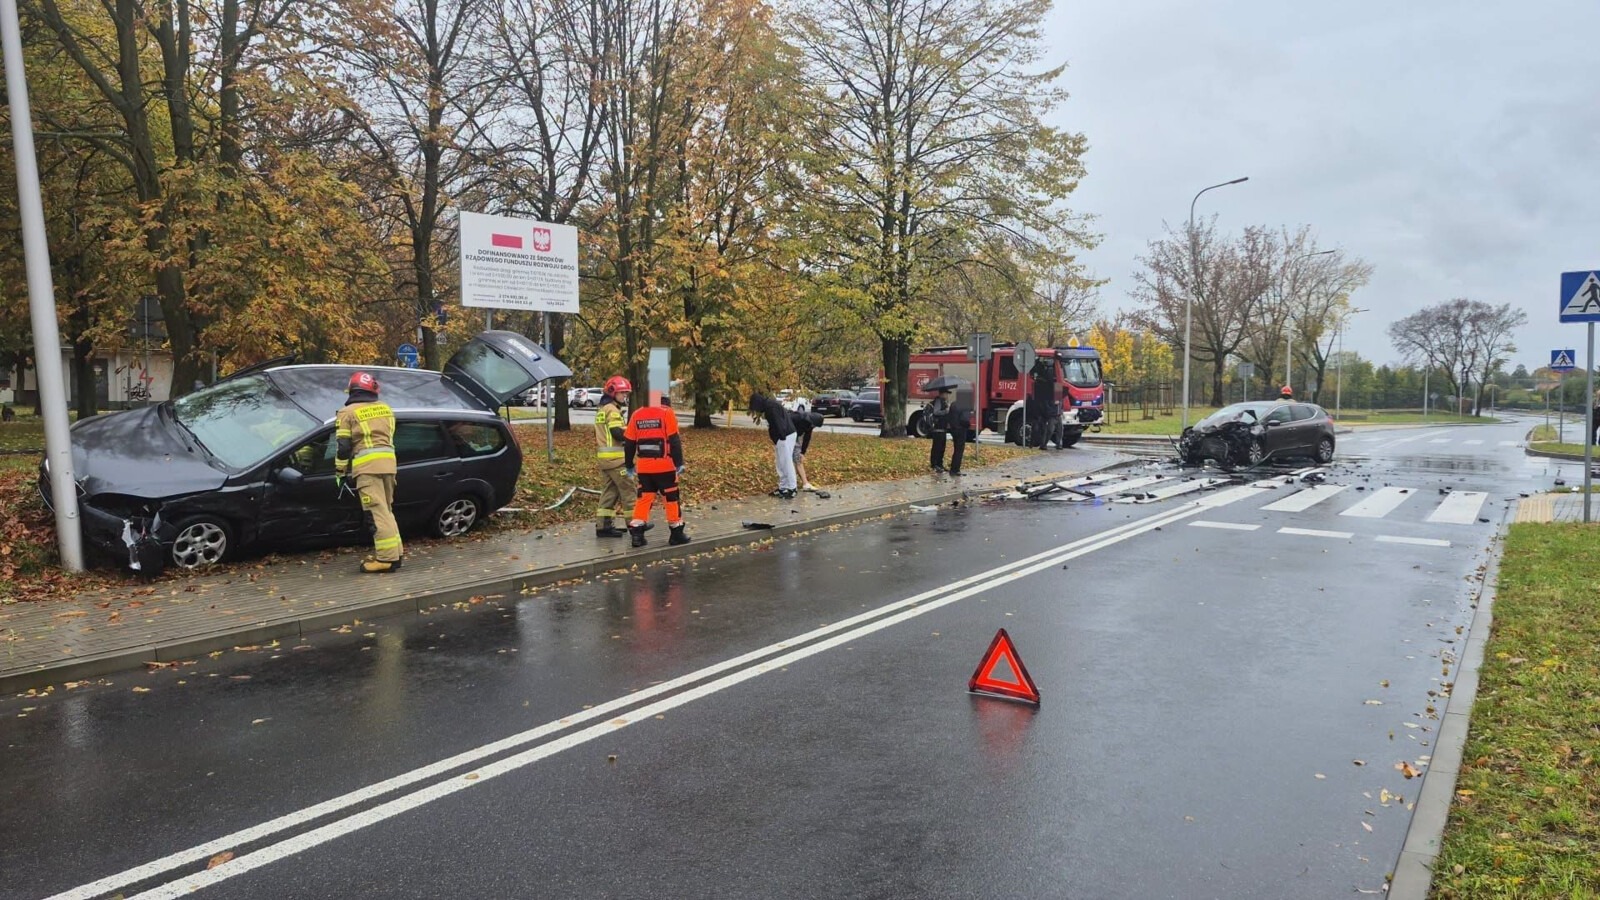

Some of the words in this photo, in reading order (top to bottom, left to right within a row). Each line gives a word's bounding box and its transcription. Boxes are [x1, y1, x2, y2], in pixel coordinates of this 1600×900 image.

[478, 249, 529, 260] DOFINANSOWANO
[465, 254, 503, 264] RZĄDOWEGO
[504, 258, 533, 266] FUNDUSZU
[534, 262, 560, 270] ROZWOJU
